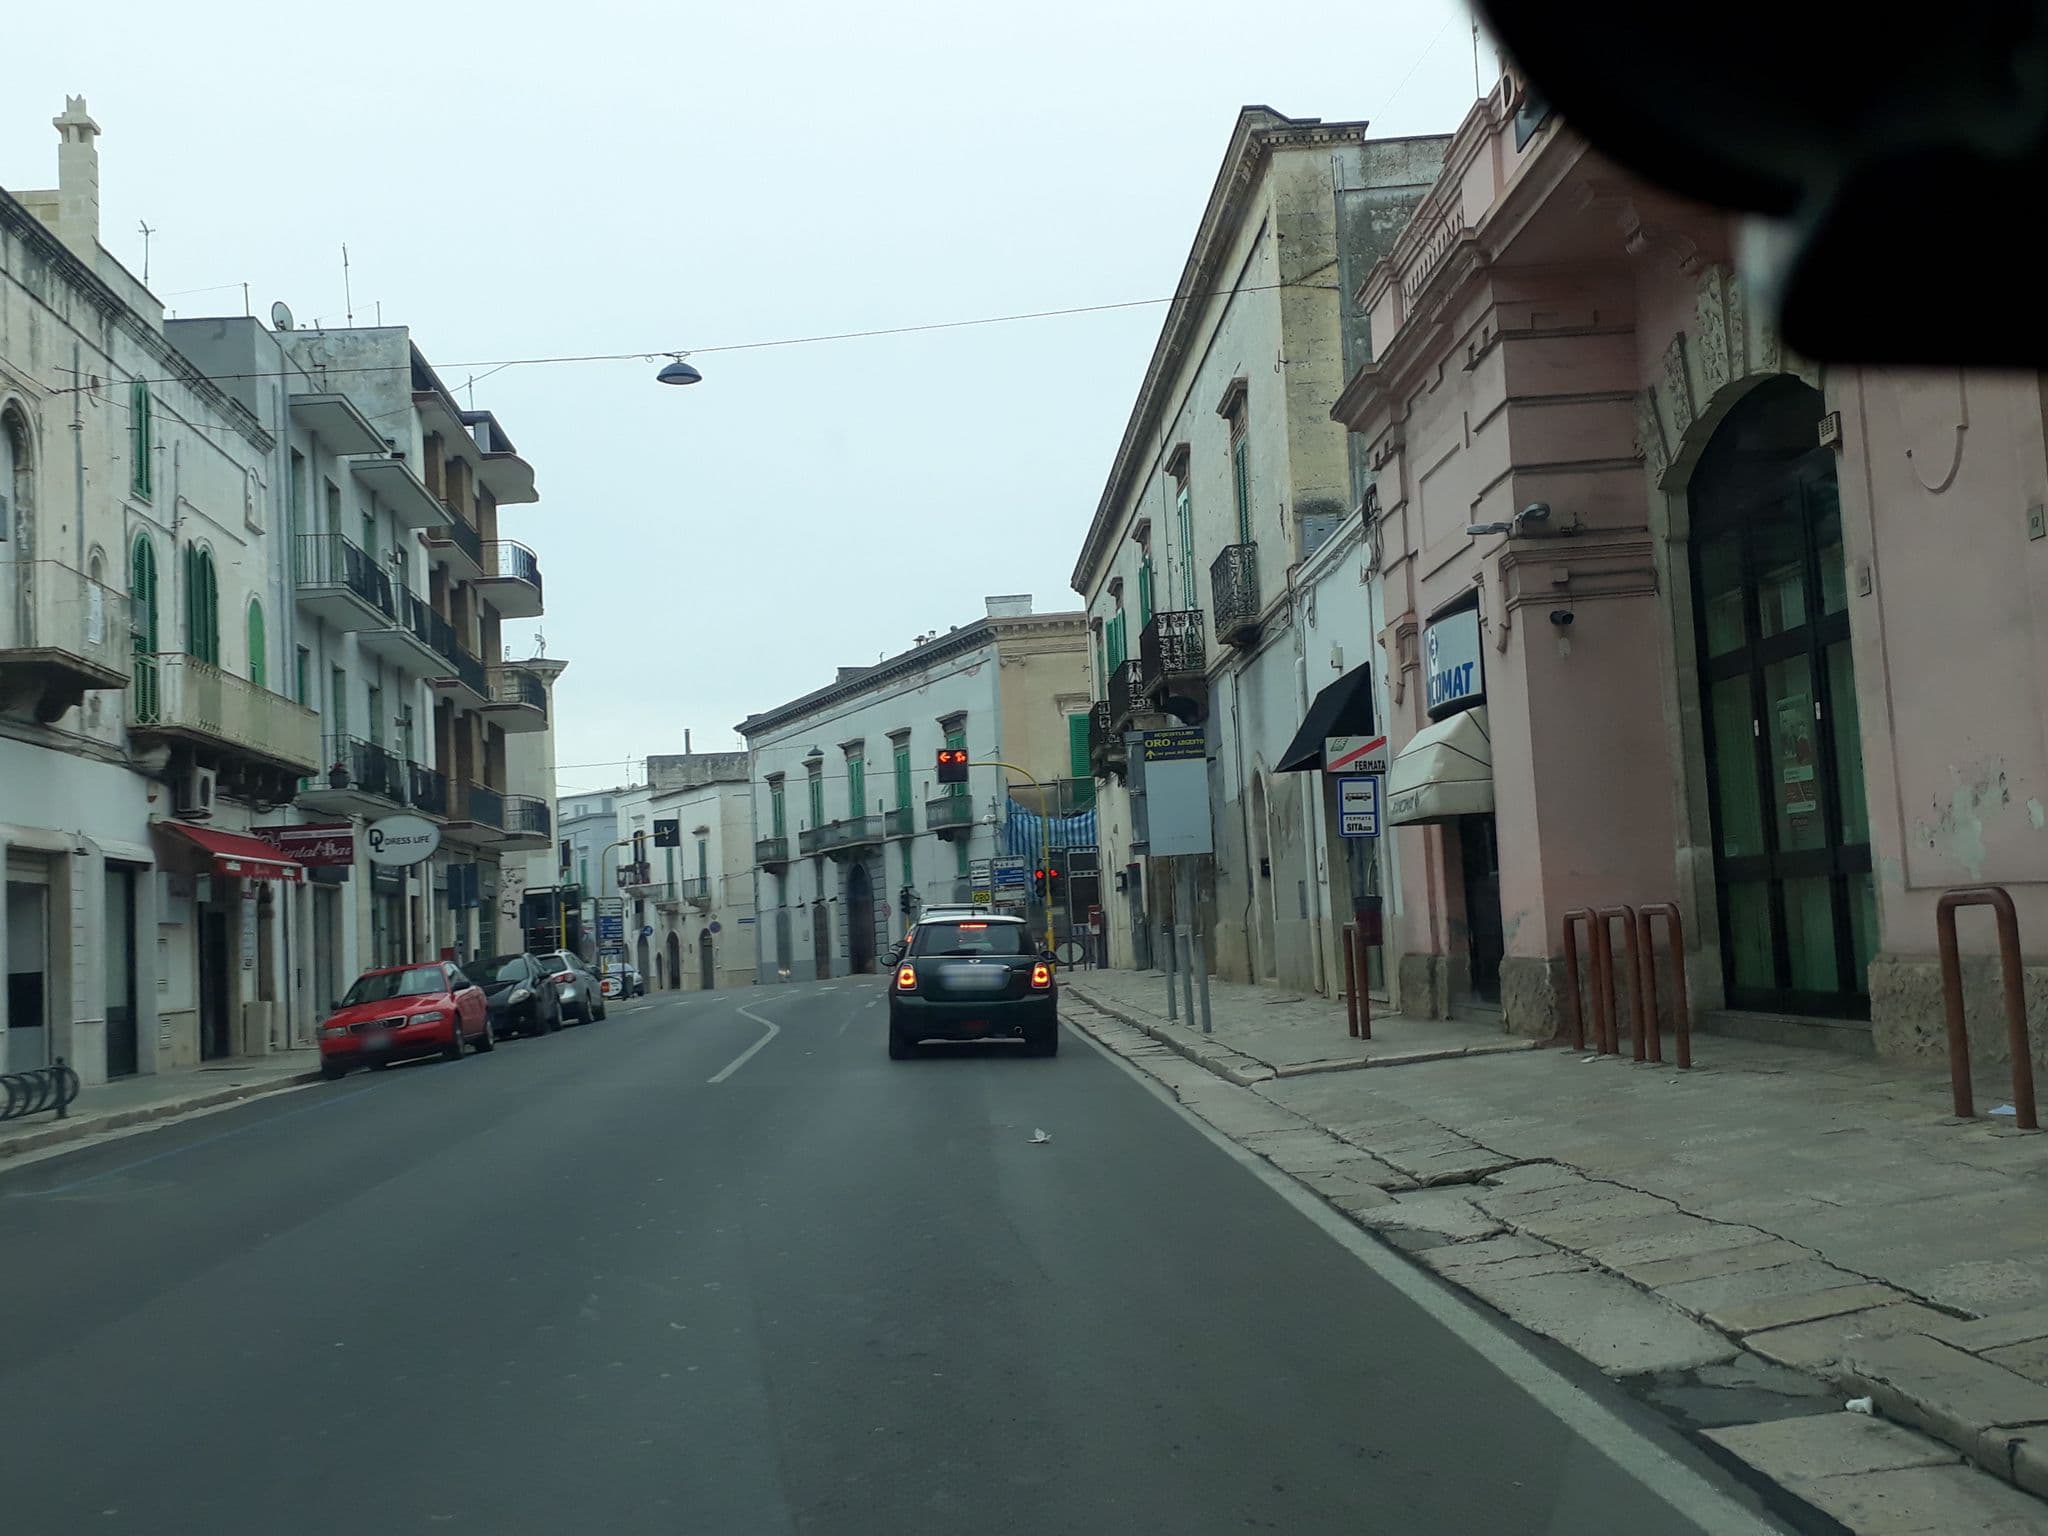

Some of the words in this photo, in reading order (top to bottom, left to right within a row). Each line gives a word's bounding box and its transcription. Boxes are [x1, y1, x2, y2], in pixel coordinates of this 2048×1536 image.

[1144, 738, 1171, 748] ORO
[1354, 760, 1386, 771] FERMATA
[1346, 823, 1363, 832] SITA
[384, 836, 411, 845] DRESS
